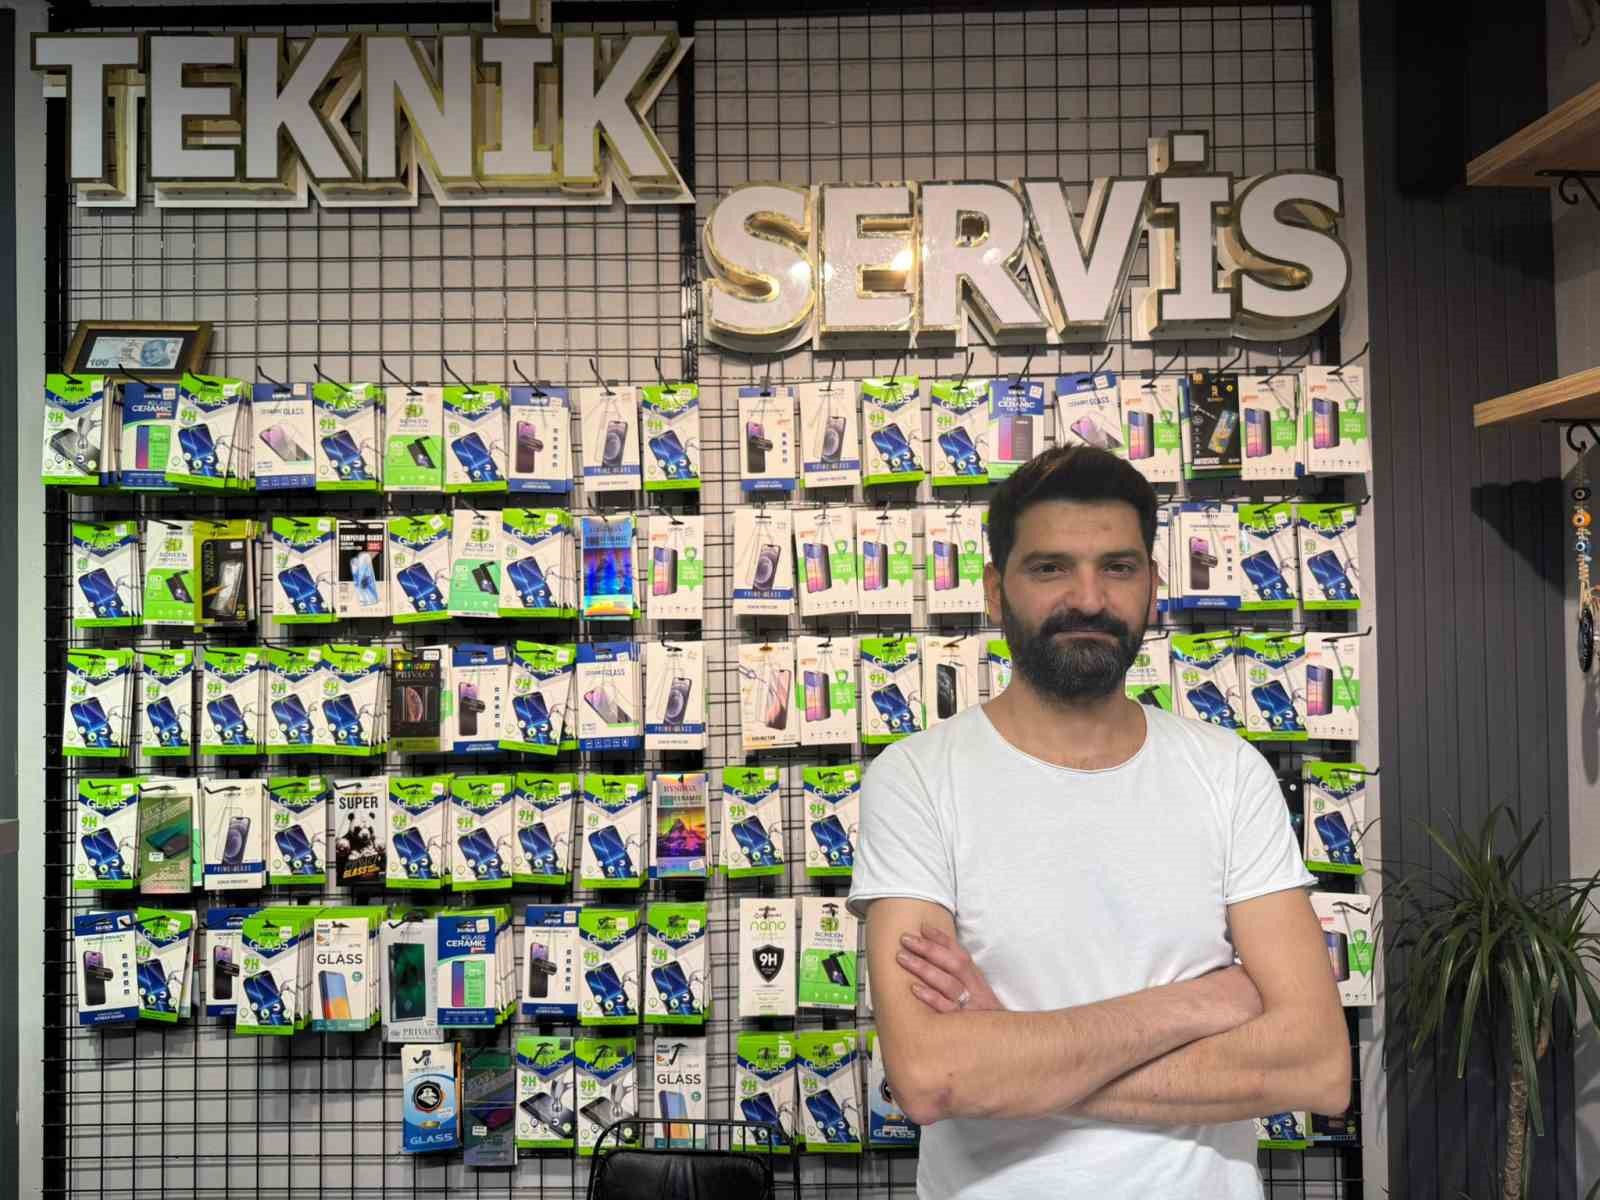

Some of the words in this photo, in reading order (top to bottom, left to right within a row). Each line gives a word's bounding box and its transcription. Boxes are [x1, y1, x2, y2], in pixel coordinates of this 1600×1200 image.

[30, 0, 690, 204] TEKNİK
[703, 130, 1351, 345] SERVİS
[131, 404, 172, 412] CERAMIC
[319, 418, 336, 429] 9H
[869, 414, 885, 424] 9H
[515, 678, 532, 689] 9H
[870, 673, 887, 684] 9H
[271, 682, 287, 693] 9H
[323, 681, 339, 692] 9H
[86, 799, 128, 808] GLASS
[339, 796, 378, 809] SUPER
[729, 805, 745, 815] 9H
[809, 804, 825, 814] 9H
[274, 815, 289, 824] 9H
[519, 809, 534, 822] 9H
[81, 816, 97, 827] 9H
[457, 817, 473, 828] 9H
[750, 920, 786, 931] nano
[243, 958, 259, 970] 9H
[317, 953, 363, 965] GLASS
[759, 952, 778, 966] 9H
[402, 1027, 439, 1036] PRIVACY
[521, 1076, 537, 1087] 9H
[657, 1074, 701, 1085] GLASS
[580, 1080, 596, 1091] 9H
[410, 1132, 453, 1145] GLASS
